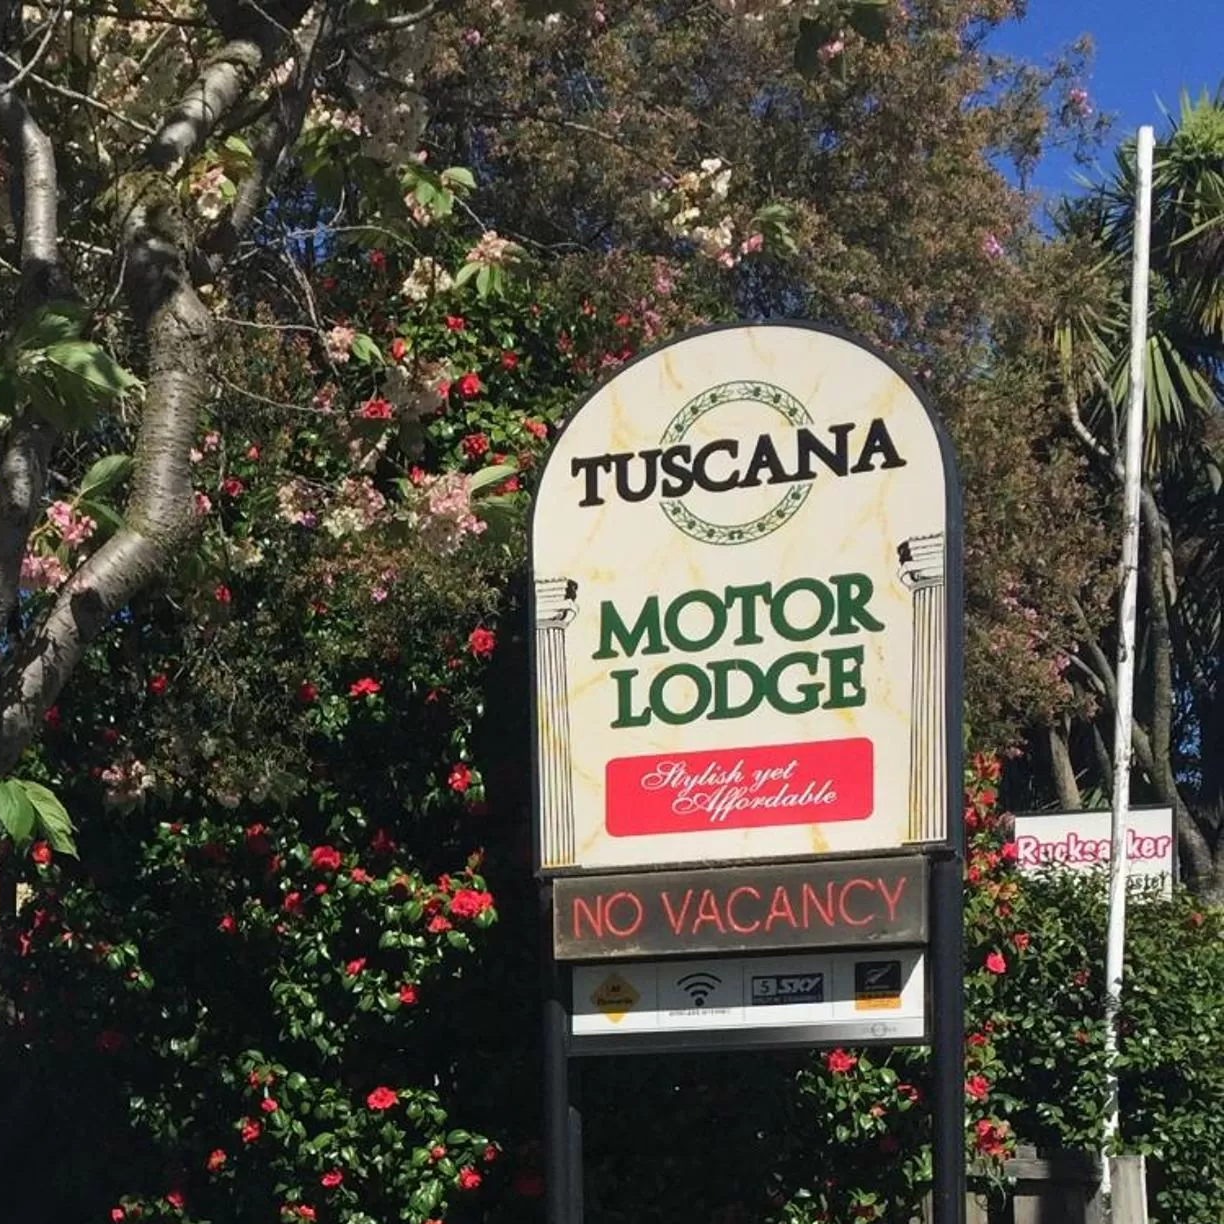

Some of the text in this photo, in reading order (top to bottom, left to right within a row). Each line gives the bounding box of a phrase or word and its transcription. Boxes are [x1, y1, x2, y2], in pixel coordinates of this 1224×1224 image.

[571, 416, 907, 507] TUSCANA
[591, 571, 886, 661] MOTOR
[609, 644, 867, 729] LODGE
[640, 759, 799, 798] Stylish yet
[671, 780, 837, 823] Affordable
[1015, 828, 1172, 866] Rucksaker
[572, 876, 907, 939] NO VACANCY
[778, 976, 822, 995] SKY
